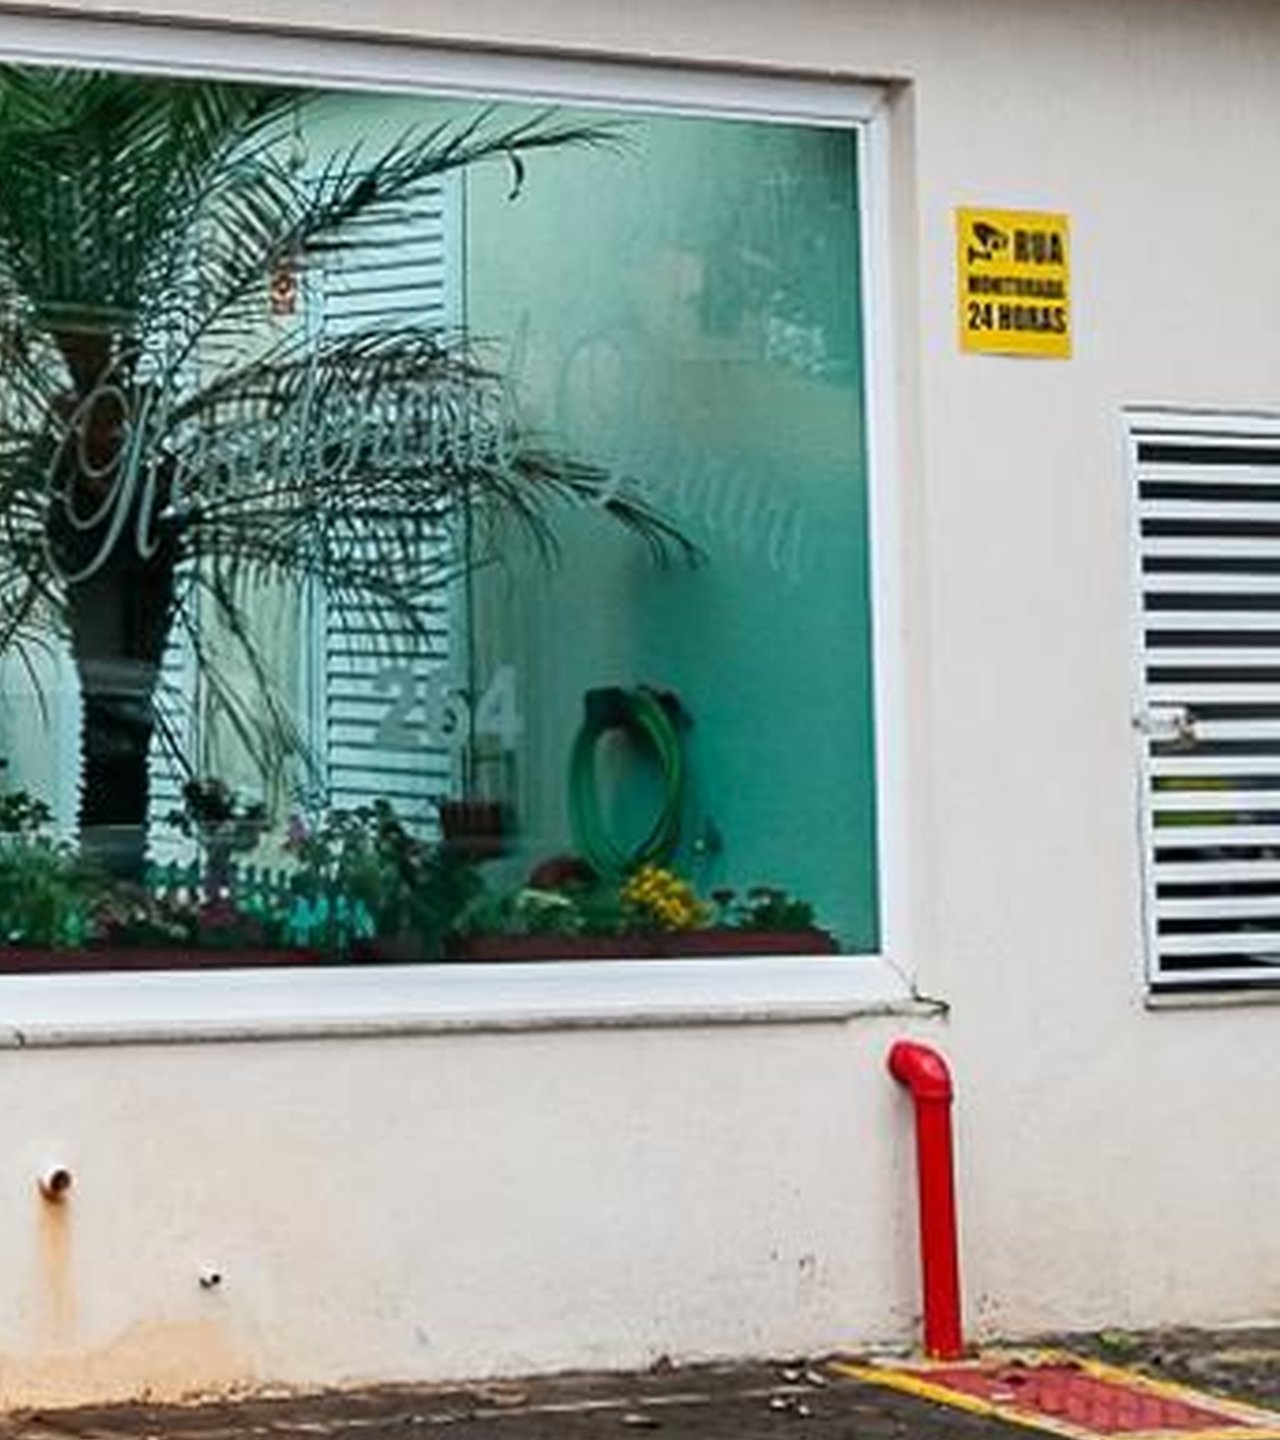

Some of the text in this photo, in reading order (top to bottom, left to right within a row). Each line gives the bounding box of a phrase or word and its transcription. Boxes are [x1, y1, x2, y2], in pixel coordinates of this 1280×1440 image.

[1013, 230, 1064, 265] RUA
[968, 300, 1067, 334] 24 HORAS
